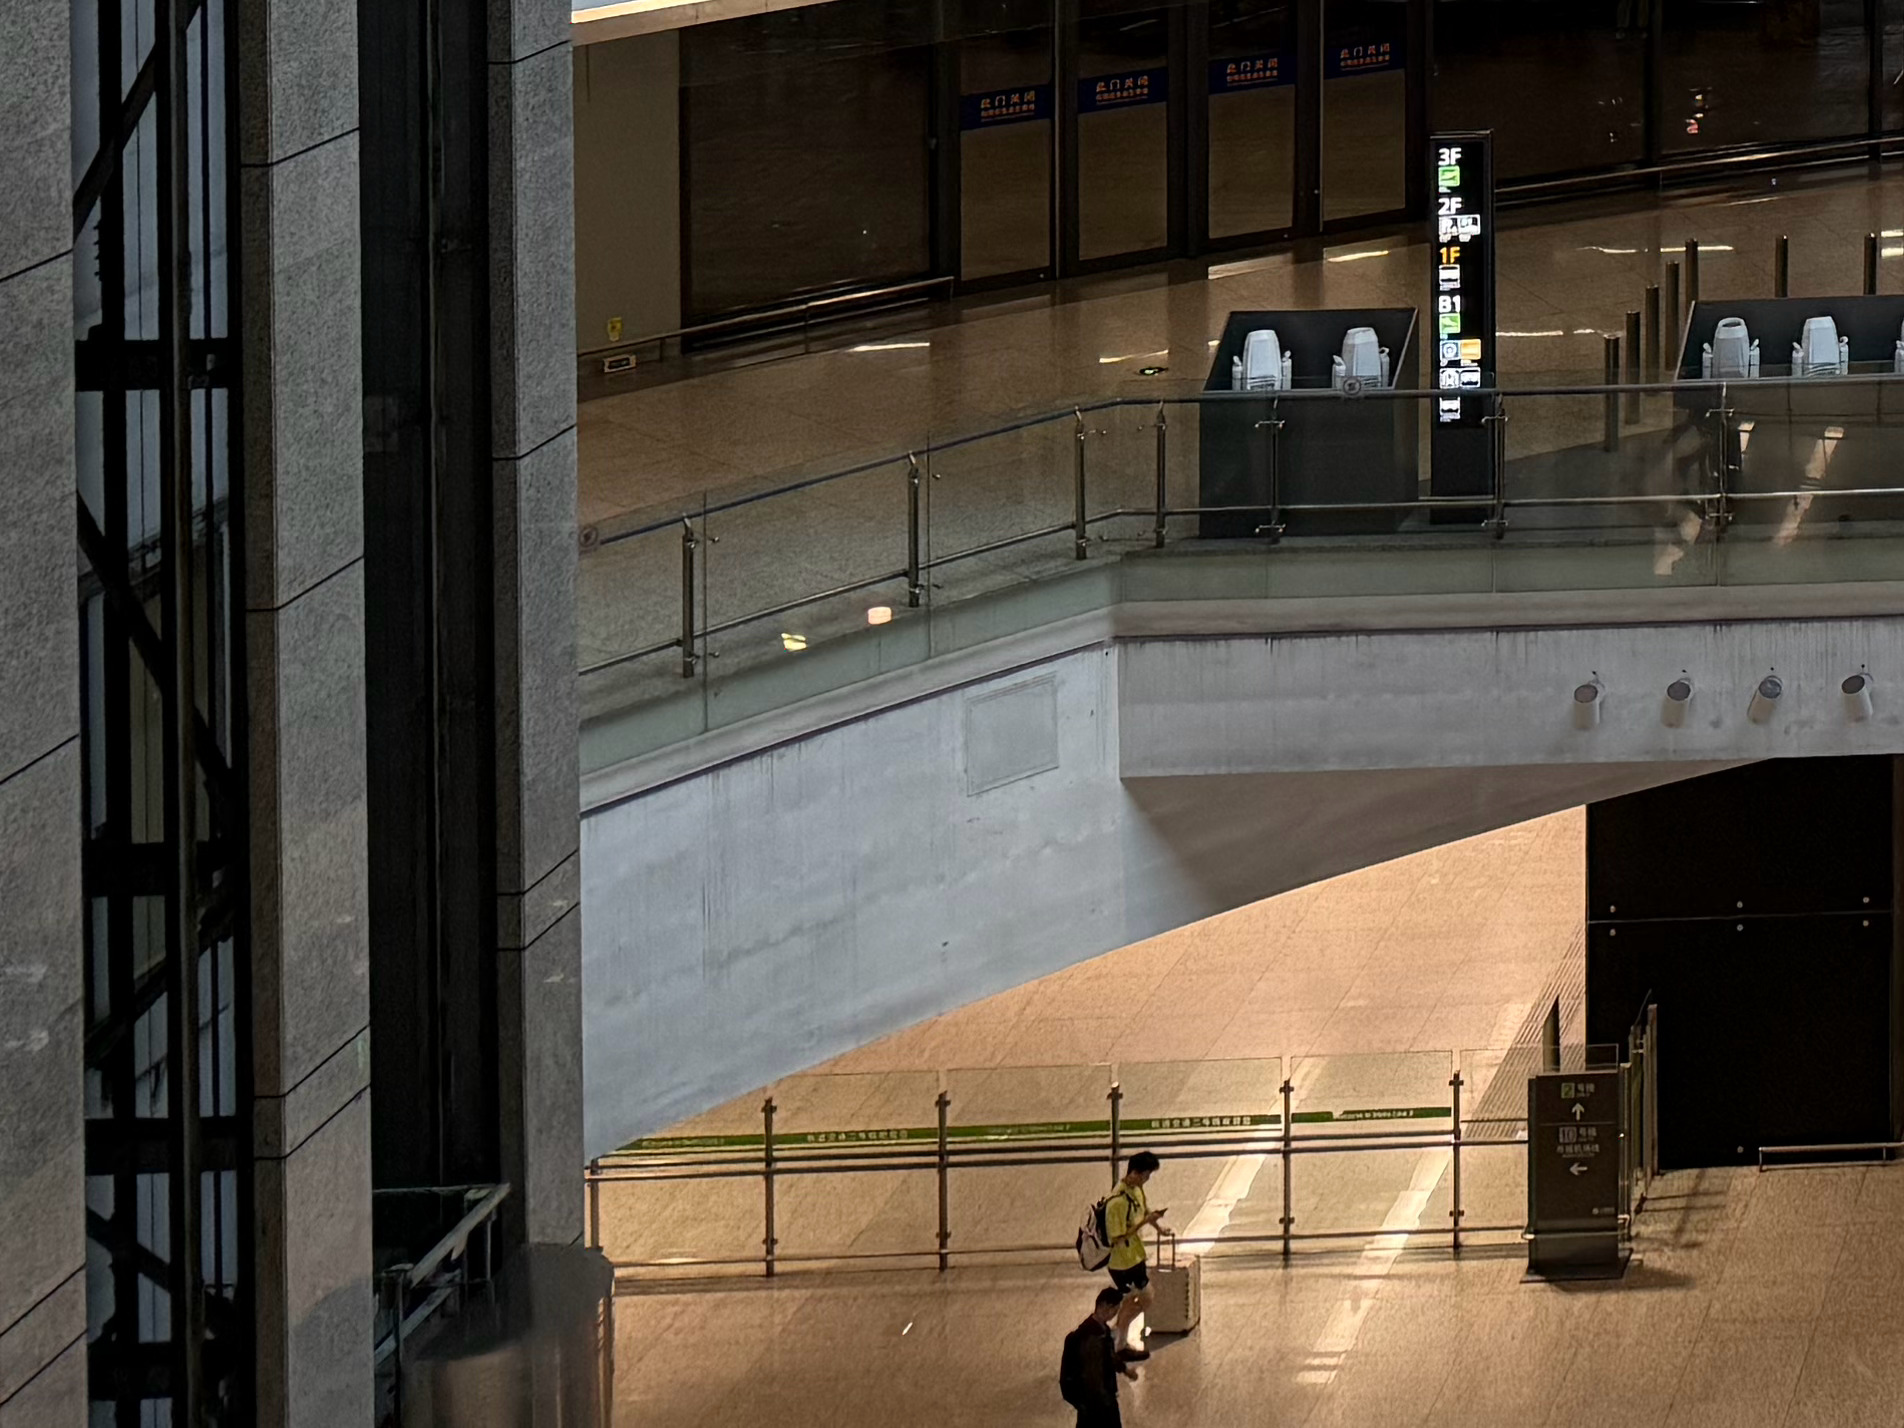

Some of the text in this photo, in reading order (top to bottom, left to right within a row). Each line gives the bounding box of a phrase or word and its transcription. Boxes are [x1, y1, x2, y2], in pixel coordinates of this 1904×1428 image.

[1438, 148, 1462, 165] 3F
[1438, 197, 1462, 215] 2F
[1439, 246, 1461, 263] 1F
[1438, 295, 1461, 312] B1
